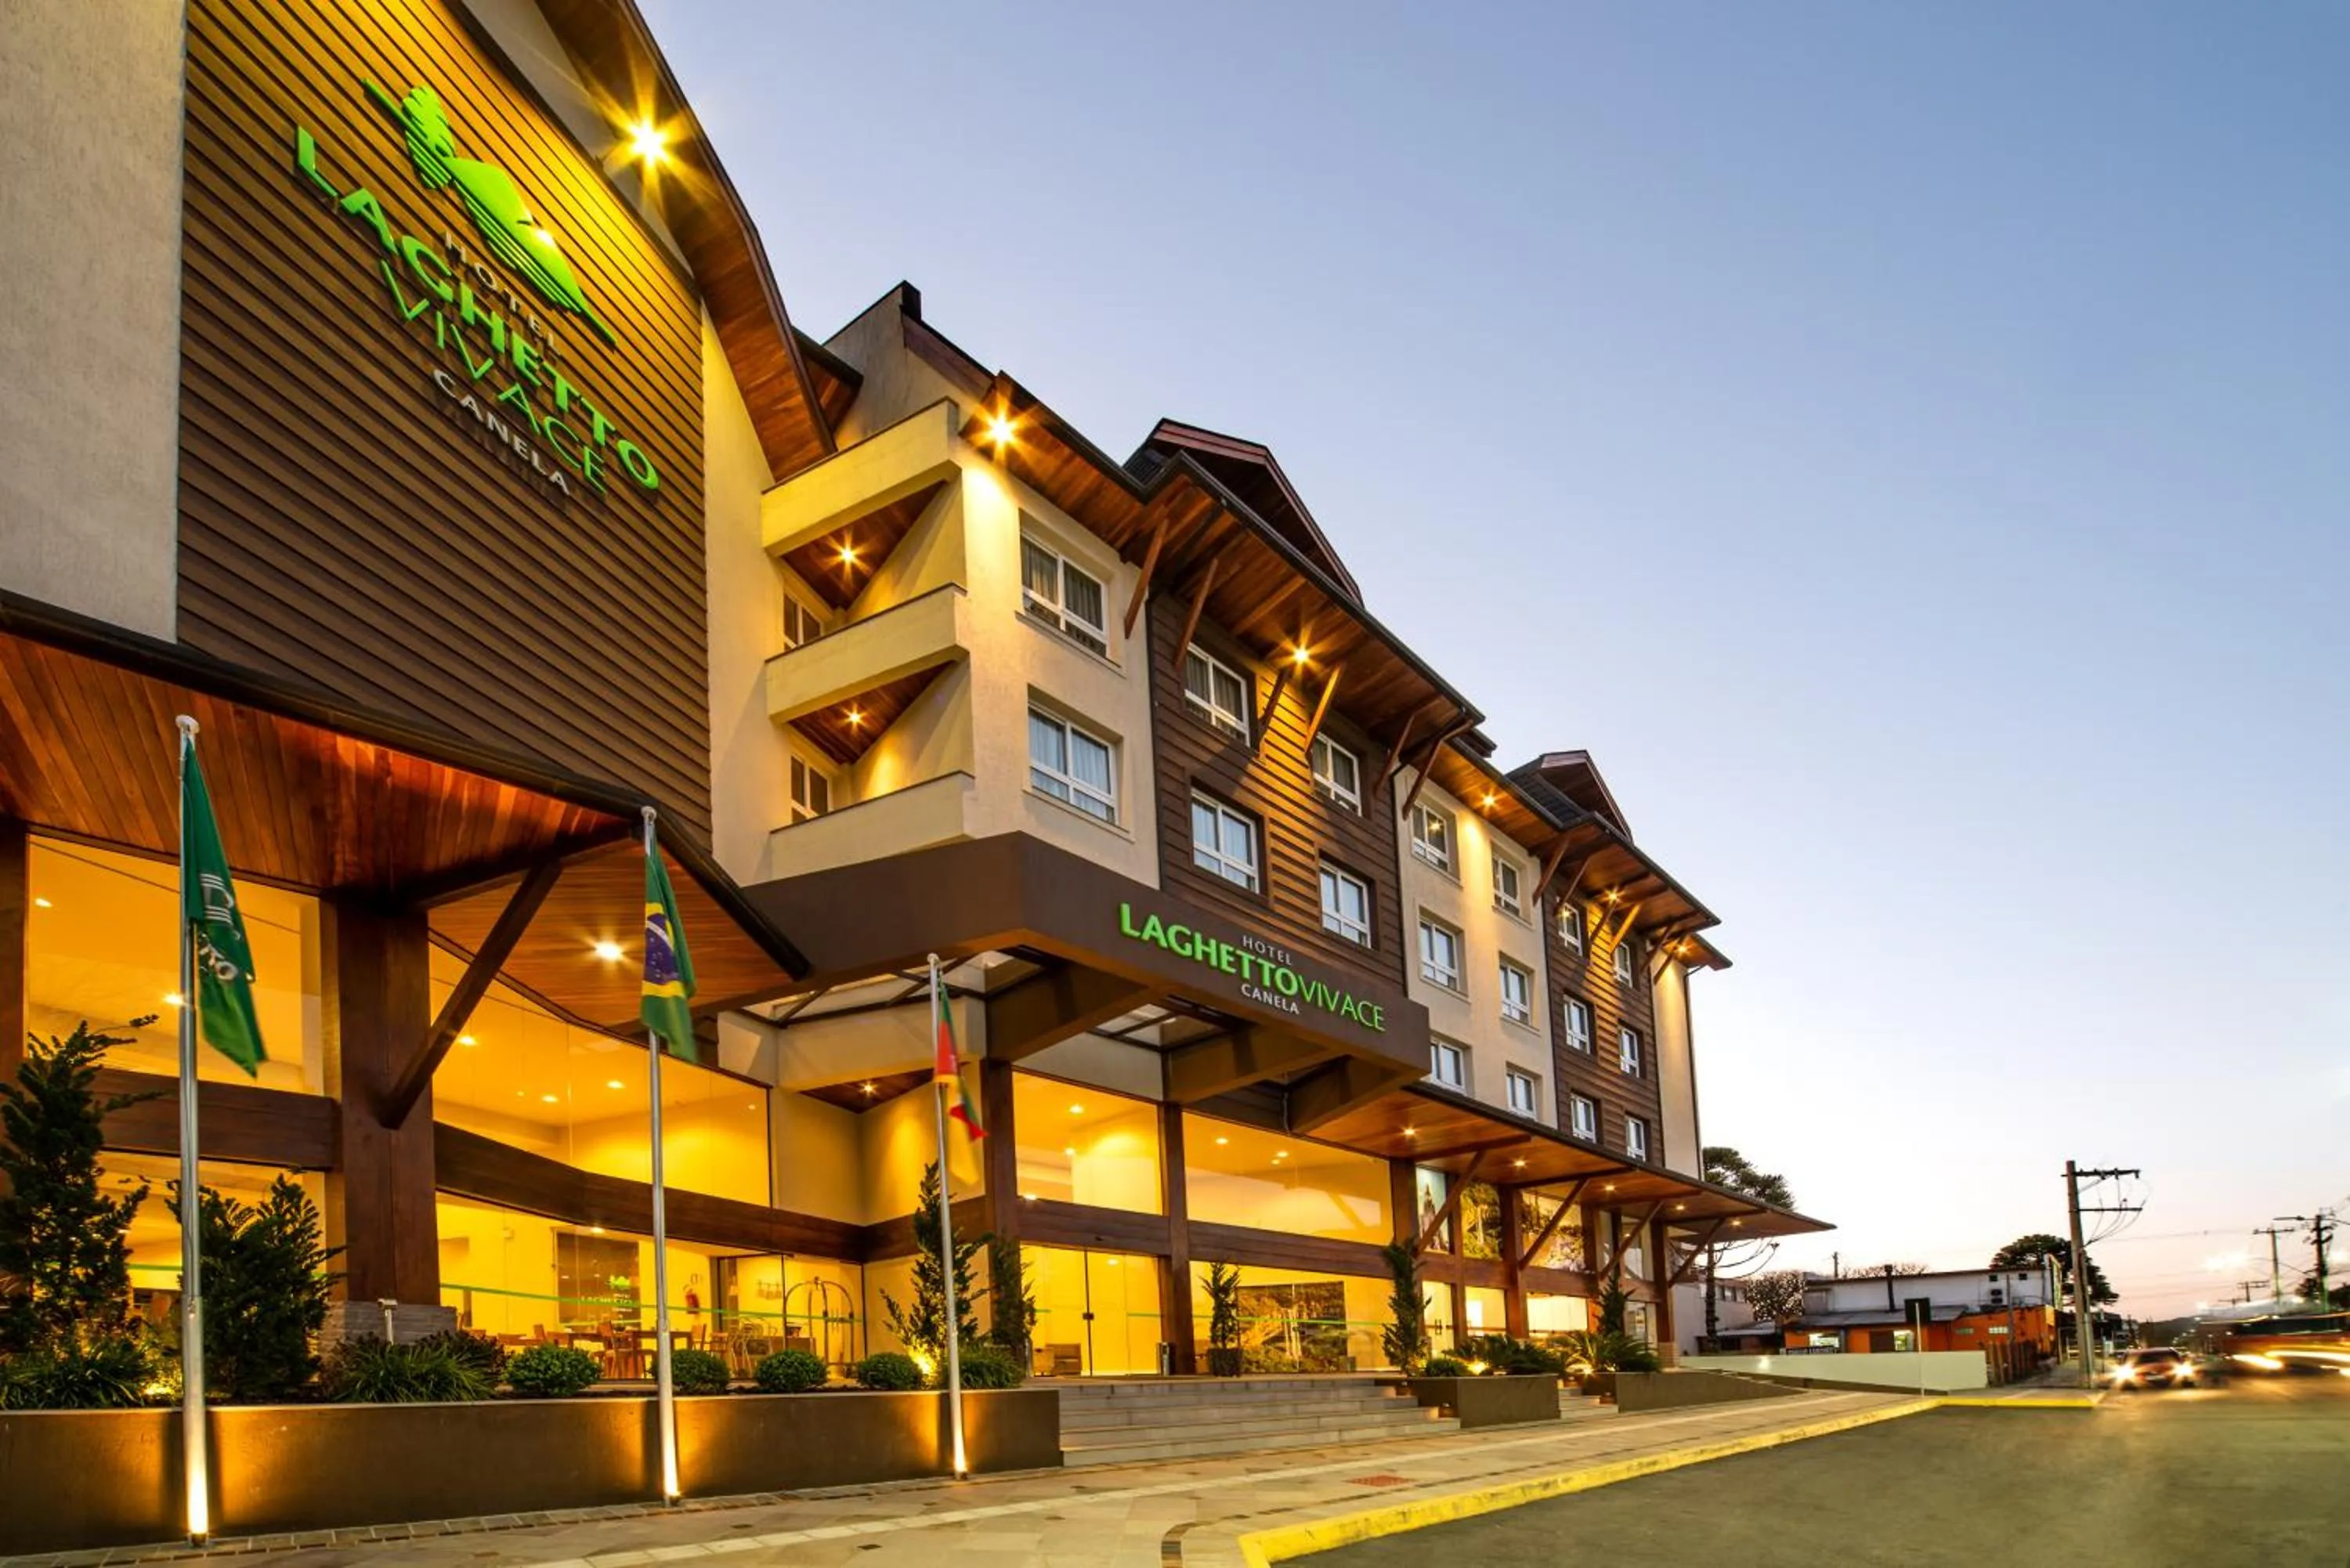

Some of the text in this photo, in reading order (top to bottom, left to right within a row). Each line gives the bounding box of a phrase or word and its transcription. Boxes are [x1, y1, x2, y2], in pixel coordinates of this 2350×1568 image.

[295, 126, 660, 490] LAGHETTO
[445, 231, 562, 356] HOTEL
[379, 259, 606, 493] VIVACE
[432, 368, 569, 495] CANELA
[1241, 983, 1300, 1015] CANELA
[1242, 935, 1292, 966] HOTEL
